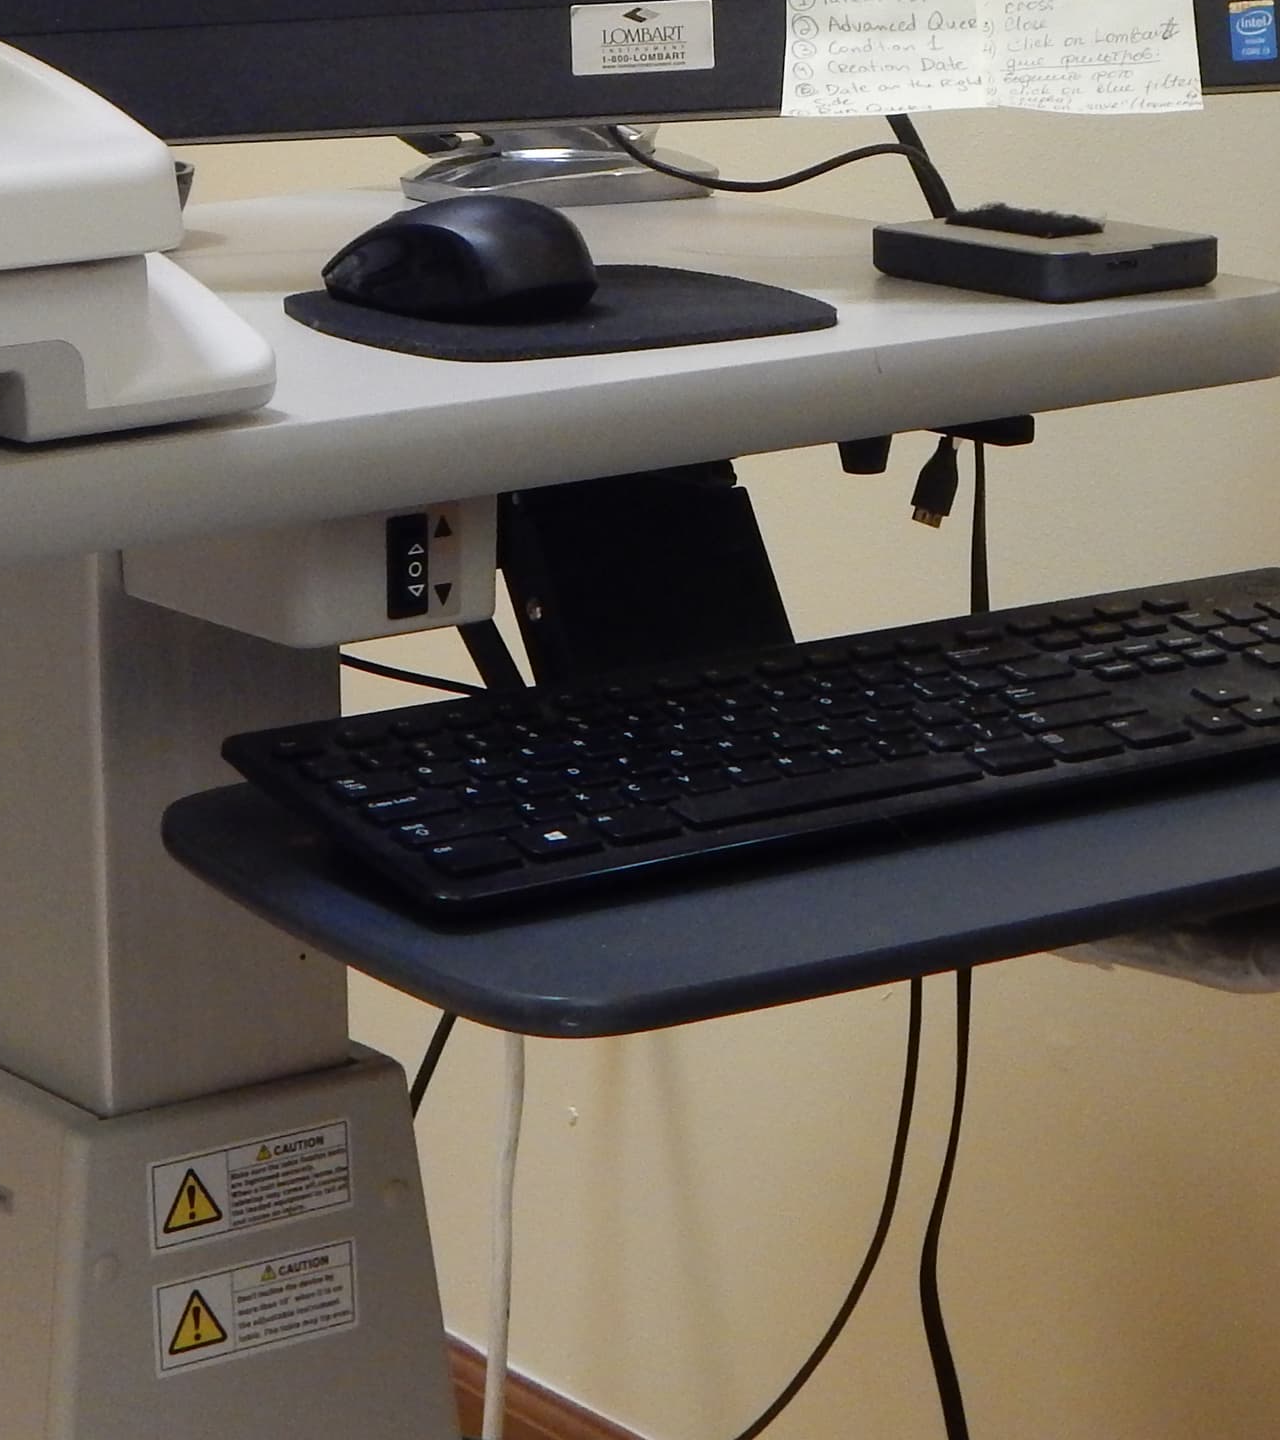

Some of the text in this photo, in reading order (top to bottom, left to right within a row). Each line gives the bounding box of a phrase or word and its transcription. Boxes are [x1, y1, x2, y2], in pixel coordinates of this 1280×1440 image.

[828, 13, 917, 33] Advanced
[602, 26, 684, 45] LOMBART
[1064, 36, 1087, 47] on
[602, 51, 686, 63] 1-800-LOMBART
[920, 55, 968, 73] Date
[826, 82, 869, 96] Date
[274, 1136, 324, 1156] CAUTION
[278, 1256, 329, 1276] CAUTION
